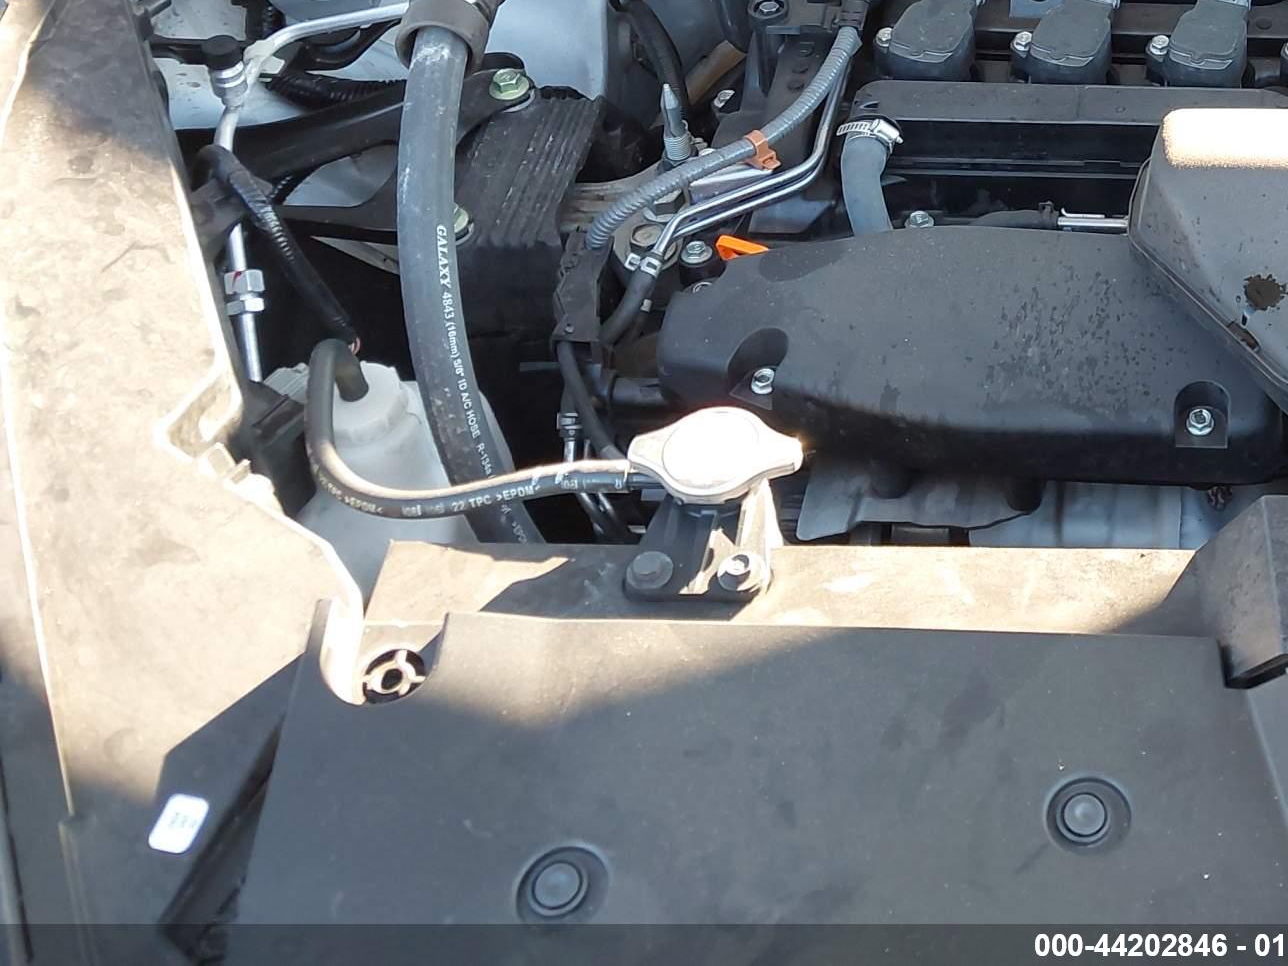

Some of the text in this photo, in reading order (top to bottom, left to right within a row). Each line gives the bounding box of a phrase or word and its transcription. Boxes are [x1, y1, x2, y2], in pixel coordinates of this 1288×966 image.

[436, 224, 451, 289] GALAXY
[442, 292, 454, 319] 4843
[445, 321, 460, 358] (16mm)
[457, 379, 467, 391] ID
[461, 392, 472, 409] A/C
[465, 410, 481, 439] HOSE
